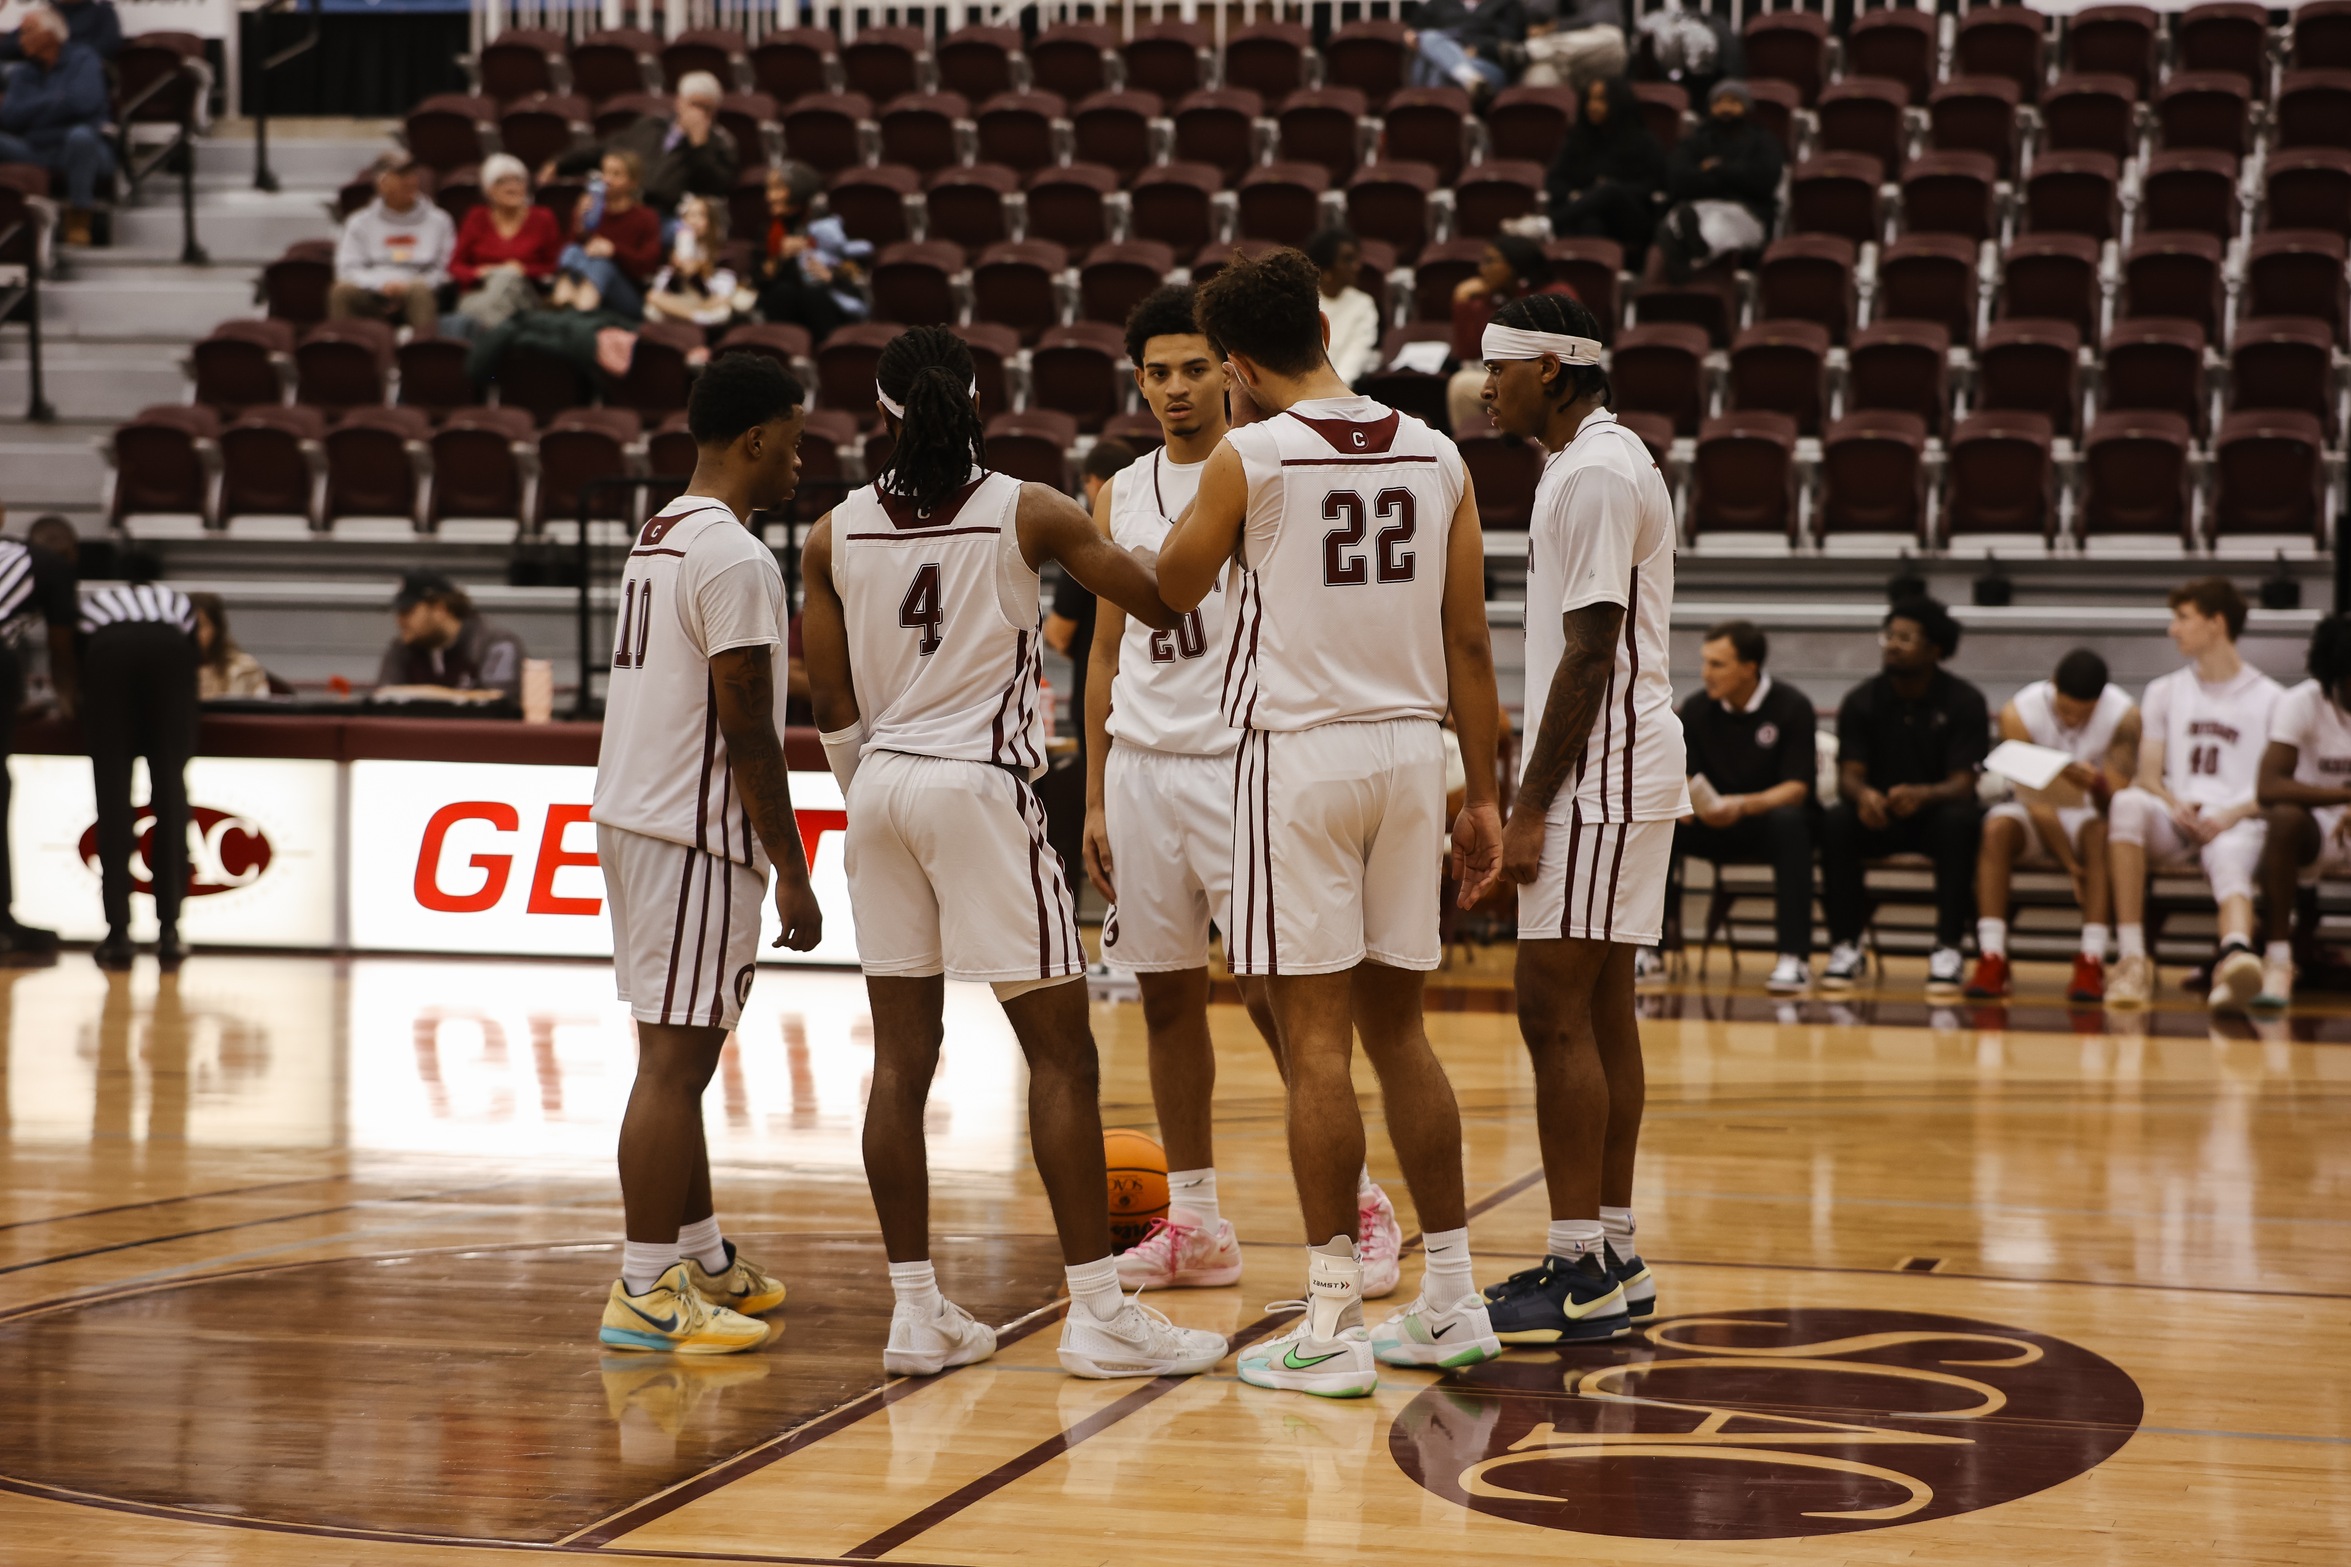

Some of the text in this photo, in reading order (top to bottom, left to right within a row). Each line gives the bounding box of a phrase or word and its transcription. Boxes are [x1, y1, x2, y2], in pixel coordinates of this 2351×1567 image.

[1352, 431, 1366, 446] C
[1322, 486, 1416, 586] 22
[614, 578, 651, 669] 10
[899, 563, 943, 656] 4
[1149, 607, 1208, 664] 20
